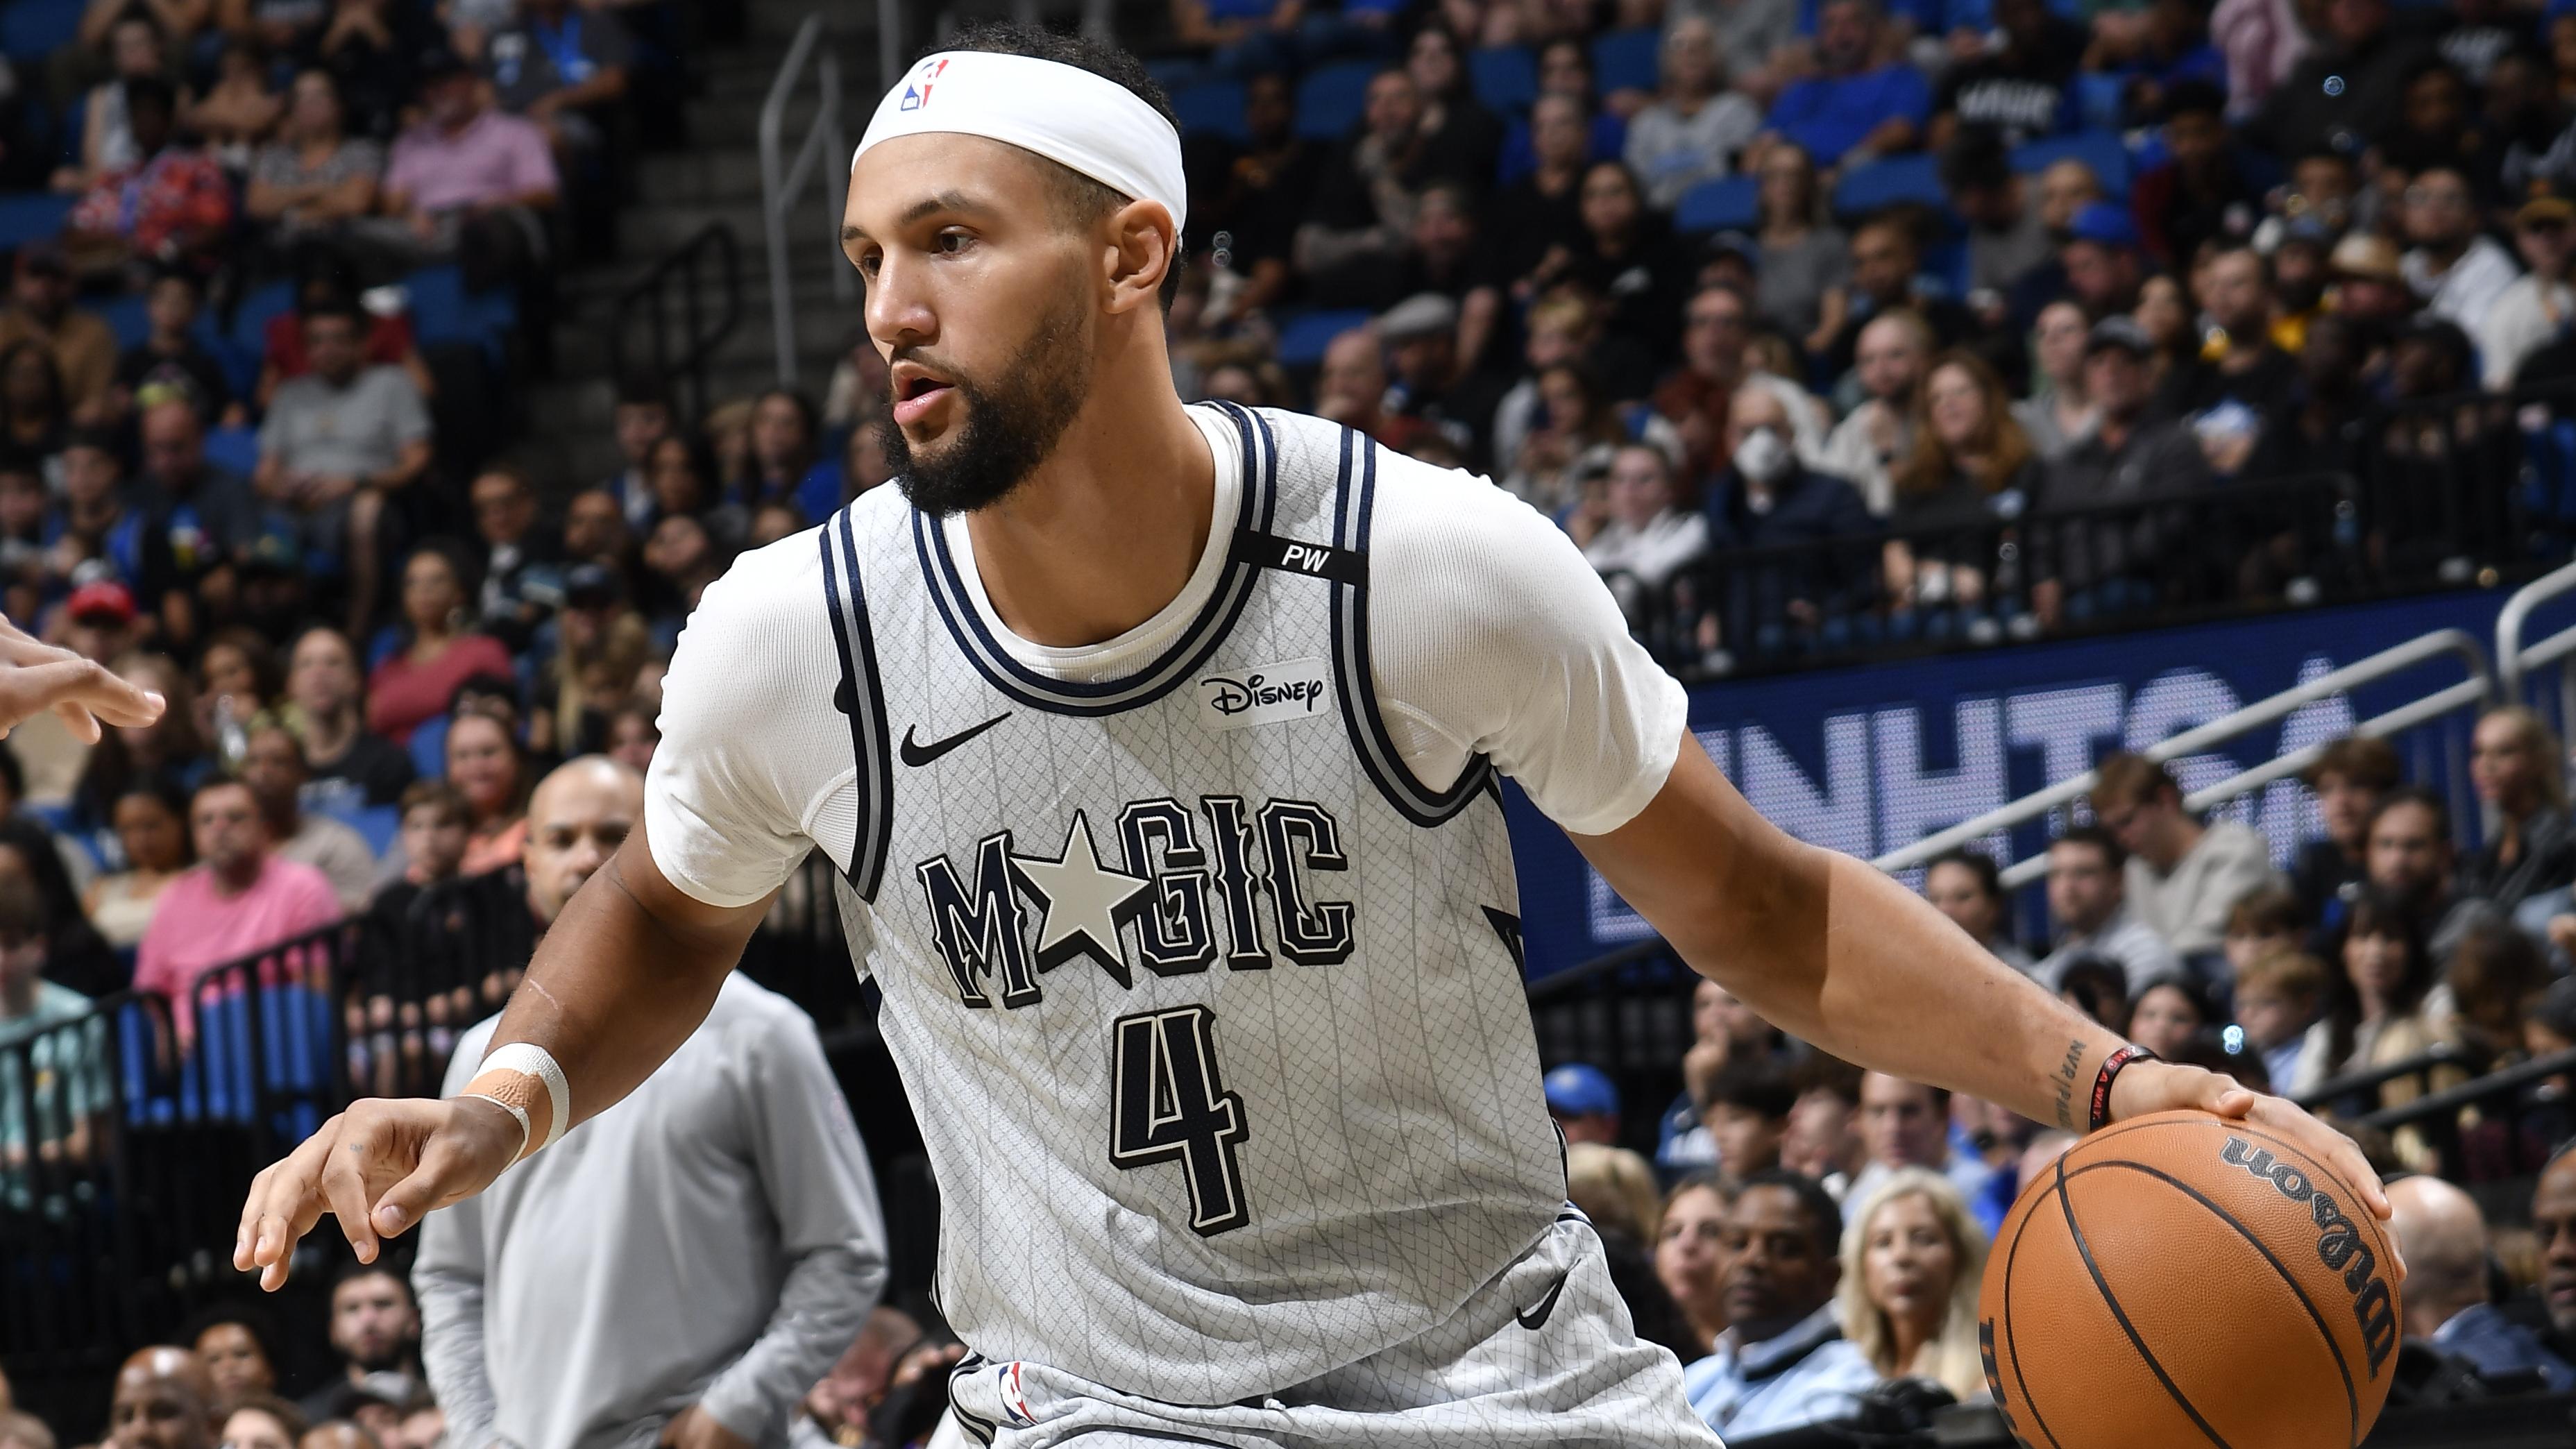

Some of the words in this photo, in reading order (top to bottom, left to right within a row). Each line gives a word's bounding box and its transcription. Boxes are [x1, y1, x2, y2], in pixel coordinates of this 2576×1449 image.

[1282, 544, 1330, 573] PW
[1201, 674, 1323, 715] Disney
[1110, 1003, 1249, 1238] 4
[2220, 1135, 2396, 1383] Wilson
